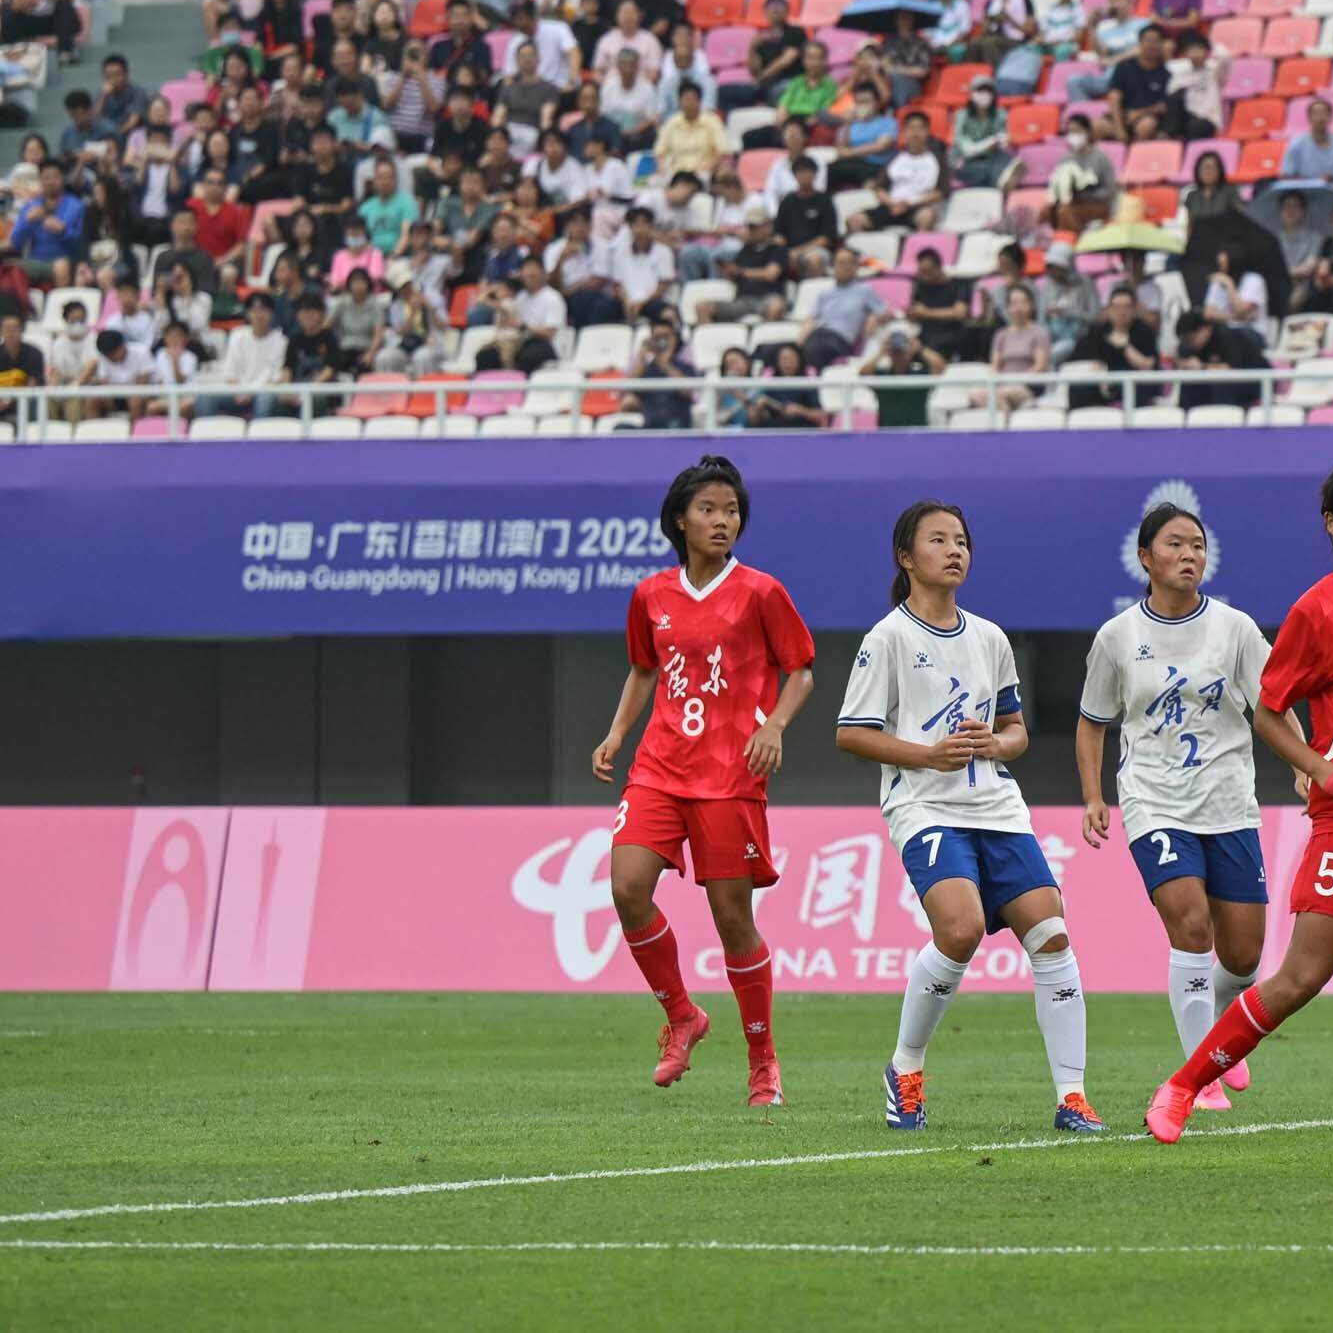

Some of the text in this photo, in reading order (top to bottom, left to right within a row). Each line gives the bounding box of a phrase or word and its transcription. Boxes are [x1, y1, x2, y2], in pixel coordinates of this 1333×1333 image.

[456, 563, 518, 592] Hong
[523, 563, 580, 591] Kong
[682, 697, 706, 737] 8
[1180, 732, 1203, 768] 2
[921, 832, 944, 867] 7
[1150, 831, 1179, 866] 2
